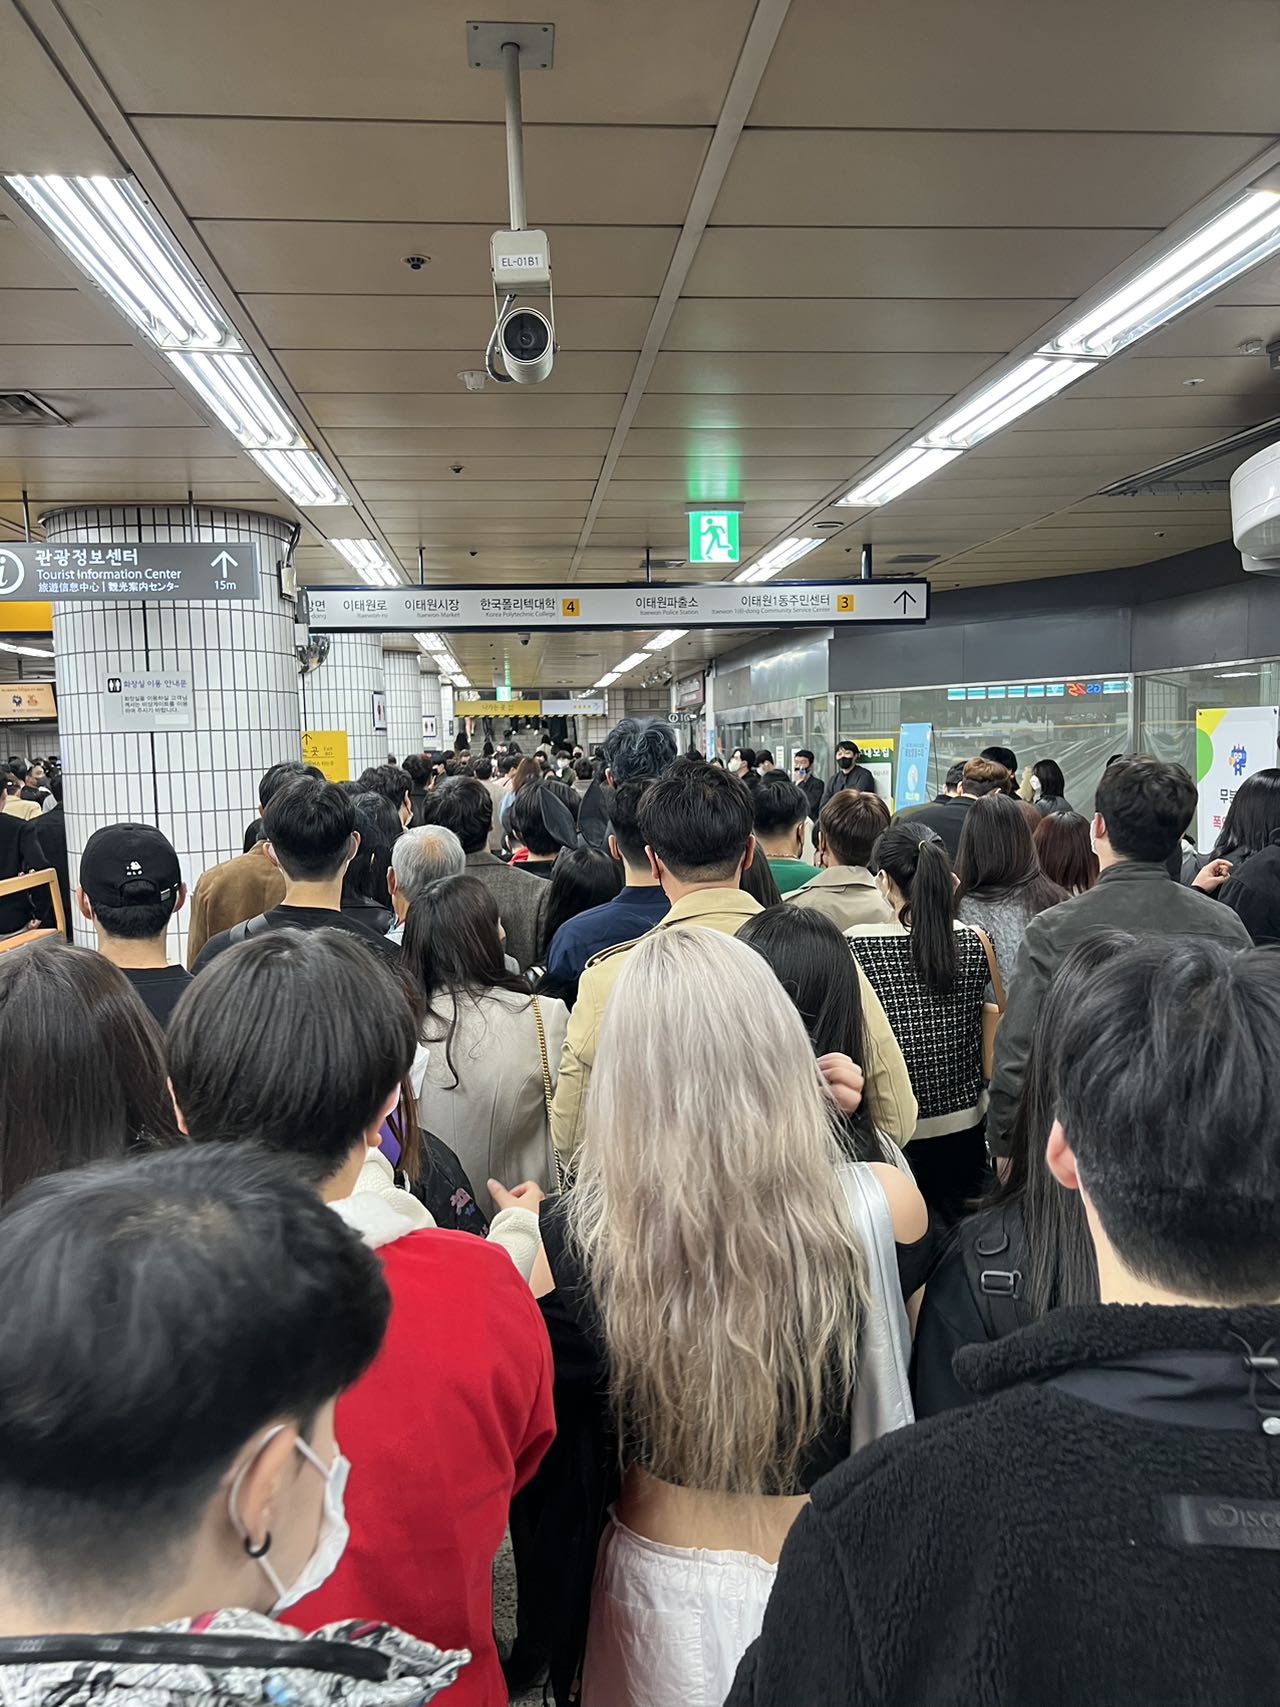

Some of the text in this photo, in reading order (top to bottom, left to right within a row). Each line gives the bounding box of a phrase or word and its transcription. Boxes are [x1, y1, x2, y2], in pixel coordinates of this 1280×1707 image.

[501, 256, 539, 267] EL-01B1
[35, 548, 138, 567] 관광정보센터
[37, 567, 182, 580] Tourist Information Center
[214, 580, 237, 590] 15m
[343, 599, 388, 612] 이태원로
[404, 598, 460, 612] 이태원시장
[480, 598, 556, 611] 한국폴리텍대학
[635, 596, 699, 609] 이태원파출소
[740, 594, 830, 607] 이태원1동주민센터
[124, 680, 145, 688] 화장실
[147, 680, 162, 688] 이용
